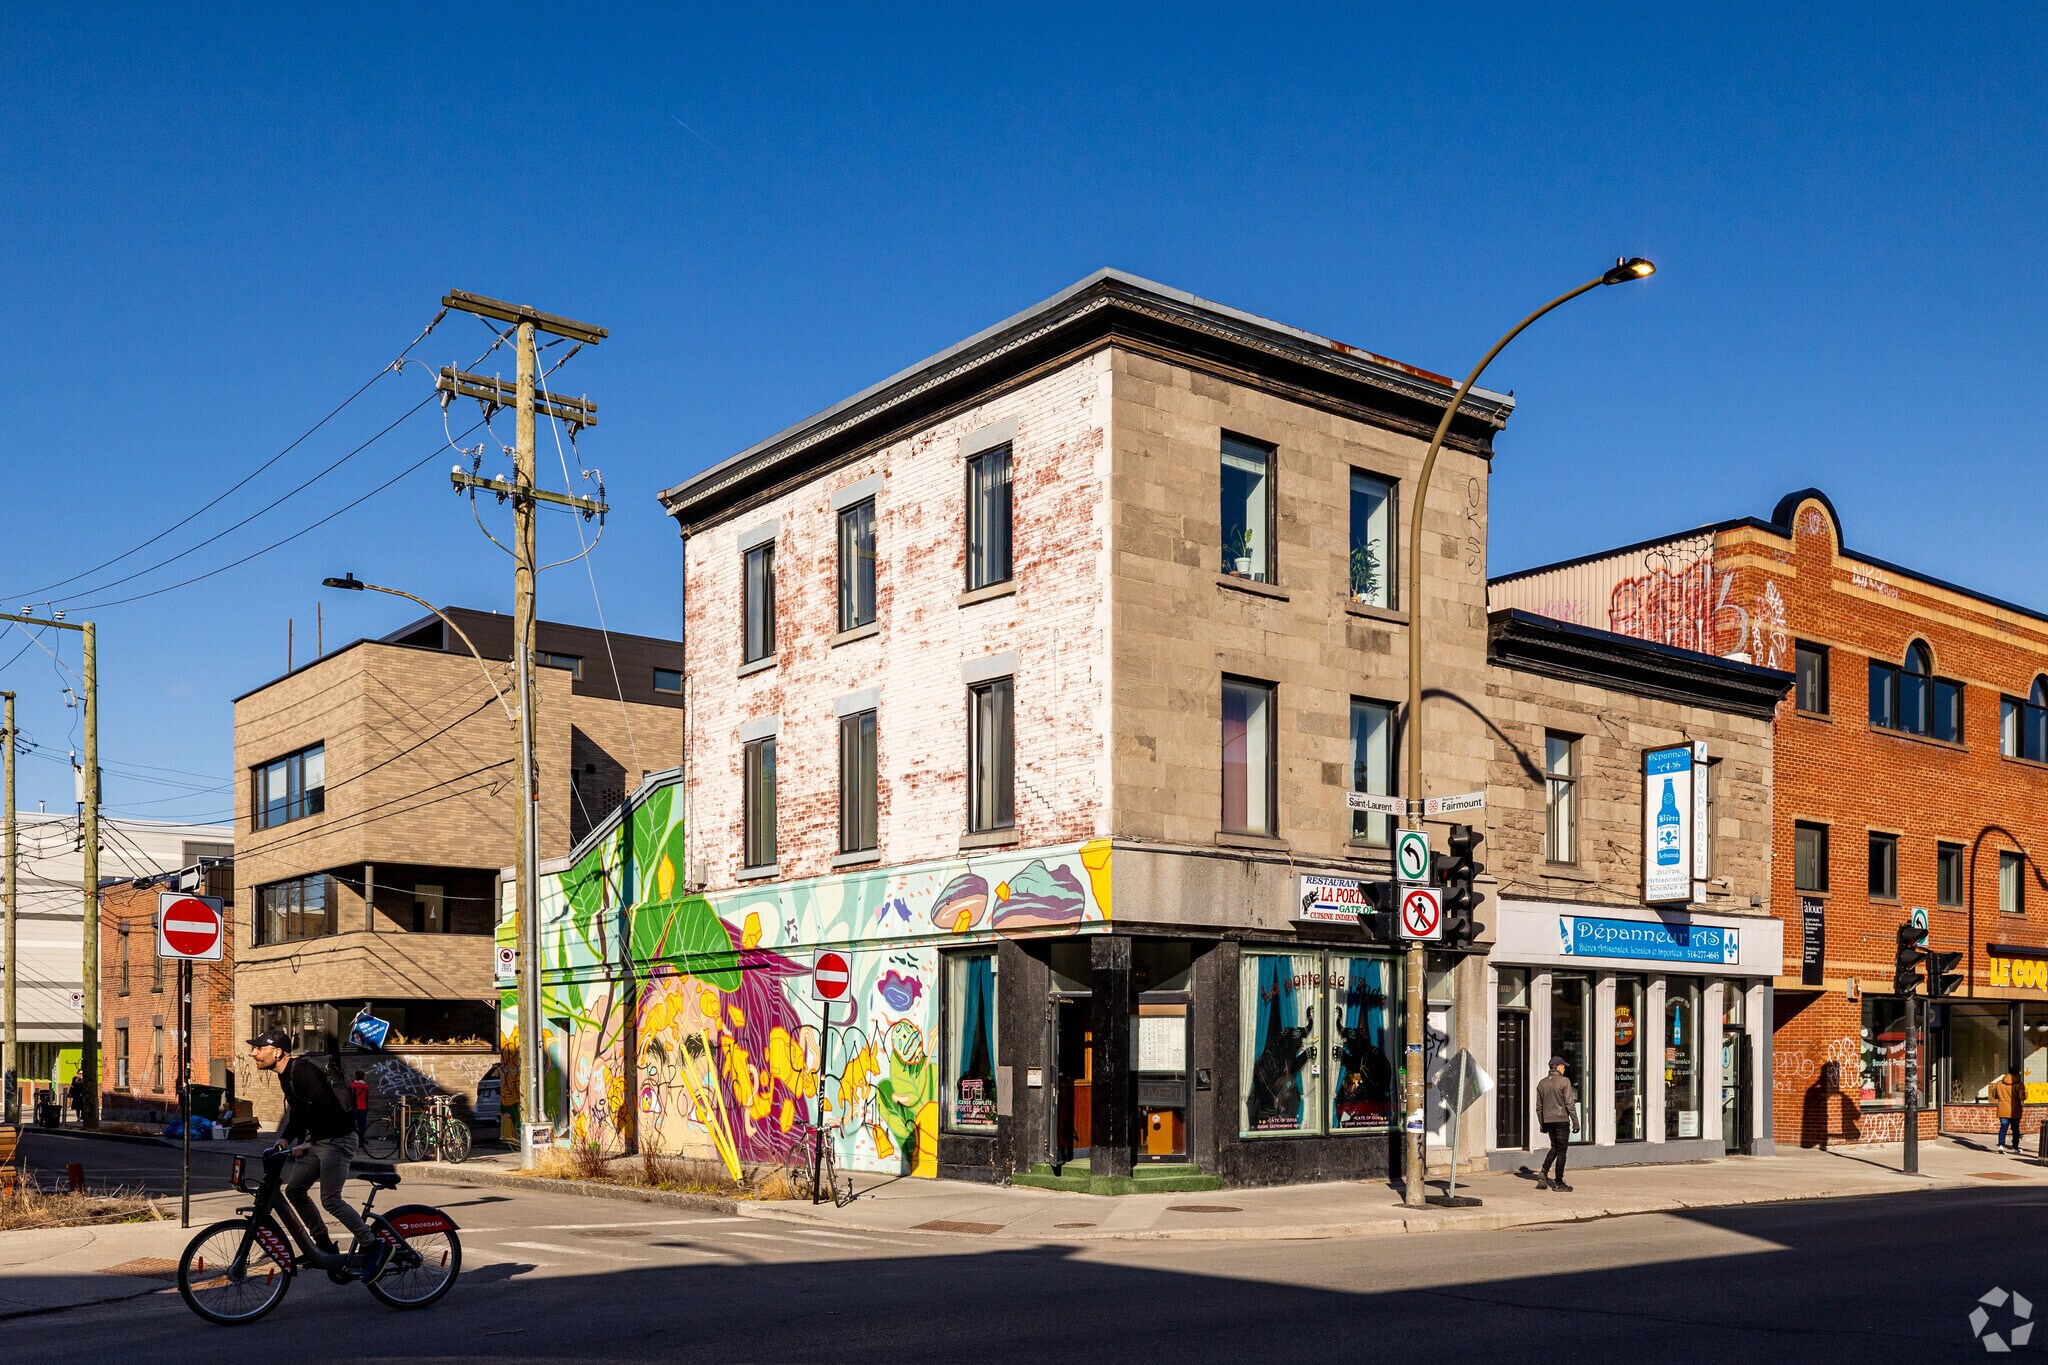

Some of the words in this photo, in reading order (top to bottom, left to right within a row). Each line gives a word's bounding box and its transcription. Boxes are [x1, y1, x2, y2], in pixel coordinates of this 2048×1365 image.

[1349, 797, 1392, 812] Saint-Laurent
[1441, 798, 1482, 811] Fairmount
[1321, 886, 1334, 902] LA
[1309, 911, 1334, 920] CUISINE
[1339, 904, 1361, 914] GATE
[1577, 921, 1688, 944] Dépanneur
[1692, 930, 1720, 947] AS
[1578, 943, 1597, 953] Bières
[1630, 946, 1651, 955] Locales
[1658, 948, 1683, 958] Importées
[1686, 950, 1720, 960] 514-277-4645
[1284, 970, 1321, 994] porte
[1329, 971, 1346, 988] de
[1990, 957, 2010, 987] LE
[2011, 958, 2048, 993] COQ
[1138, 1087, 1180, 1099] UVERT
[410, 1221, 443, 1229] DOORDASH
